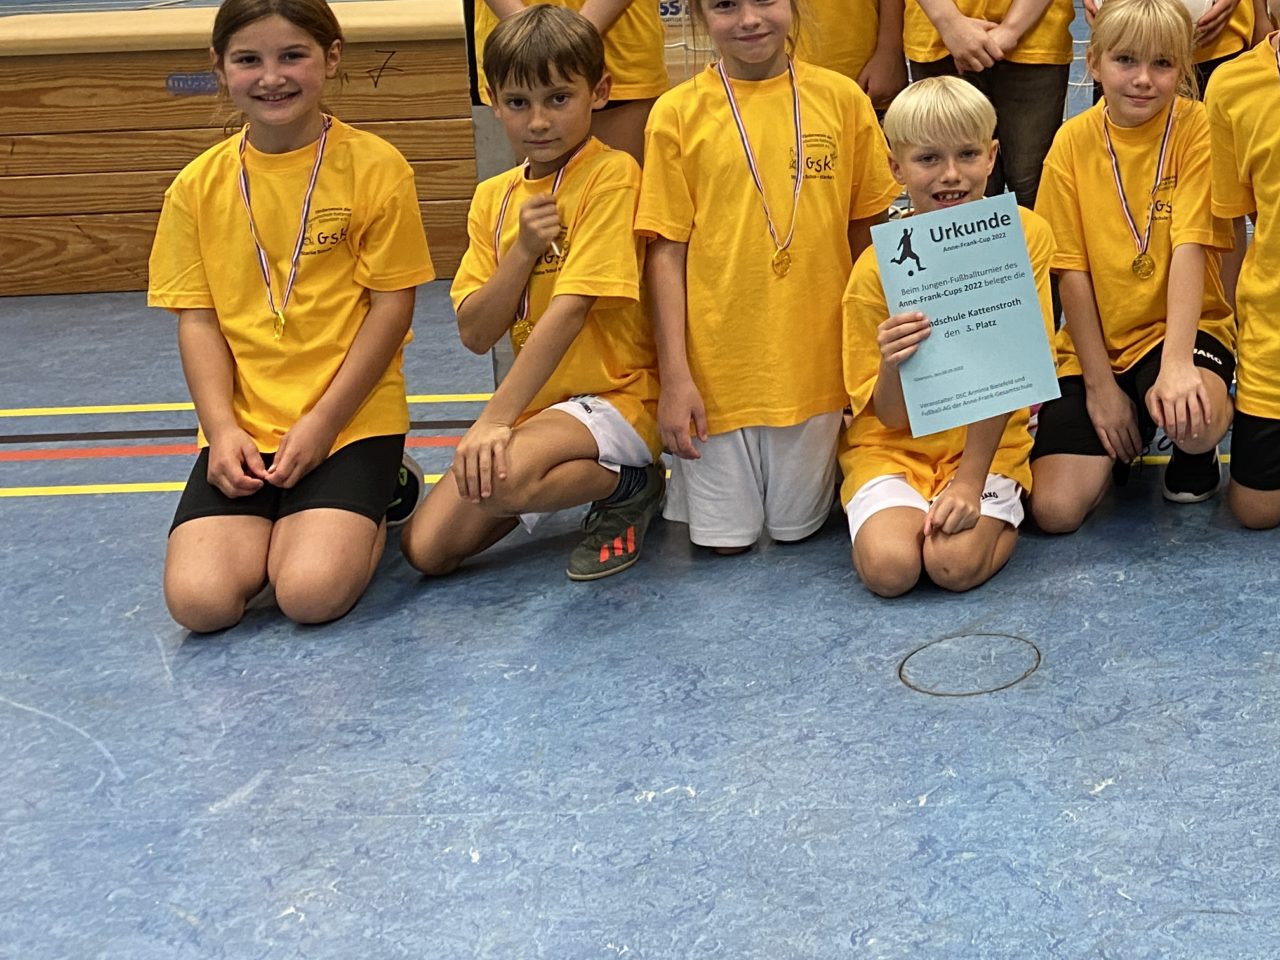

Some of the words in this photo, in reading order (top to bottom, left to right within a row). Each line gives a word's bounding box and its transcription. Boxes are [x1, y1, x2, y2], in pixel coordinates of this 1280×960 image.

[806, 155, 832, 173] GSK
[1155, 199, 1172, 214] GS
[930, 212, 1012, 243] Urkunde
[943, 236, 992, 252] Anne-Frank-Cup
[992, 232, 1007, 241] 2022
[901, 286, 920, 296] Beim
[921, 266, 1003, 291] Jungen-Fußballturnier
[1004, 261, 1018, 271] des
[898, 287, 963, 308] Anne-Frank-Cups
[964, 281, 983, 292] 2022
[984, 274, 1013, 287] belegte
[1014, 271, 1026, 279] die
[928, 312, 966, 328] ndschule
[967, 298, 1022, 318] Kattenstroth
[944, 328, 960, 339] den
[975, 319, 997, 331] Platz
[1193, 348, 1222, 365] JAKO
[1015, 376, 1026, 384] und
